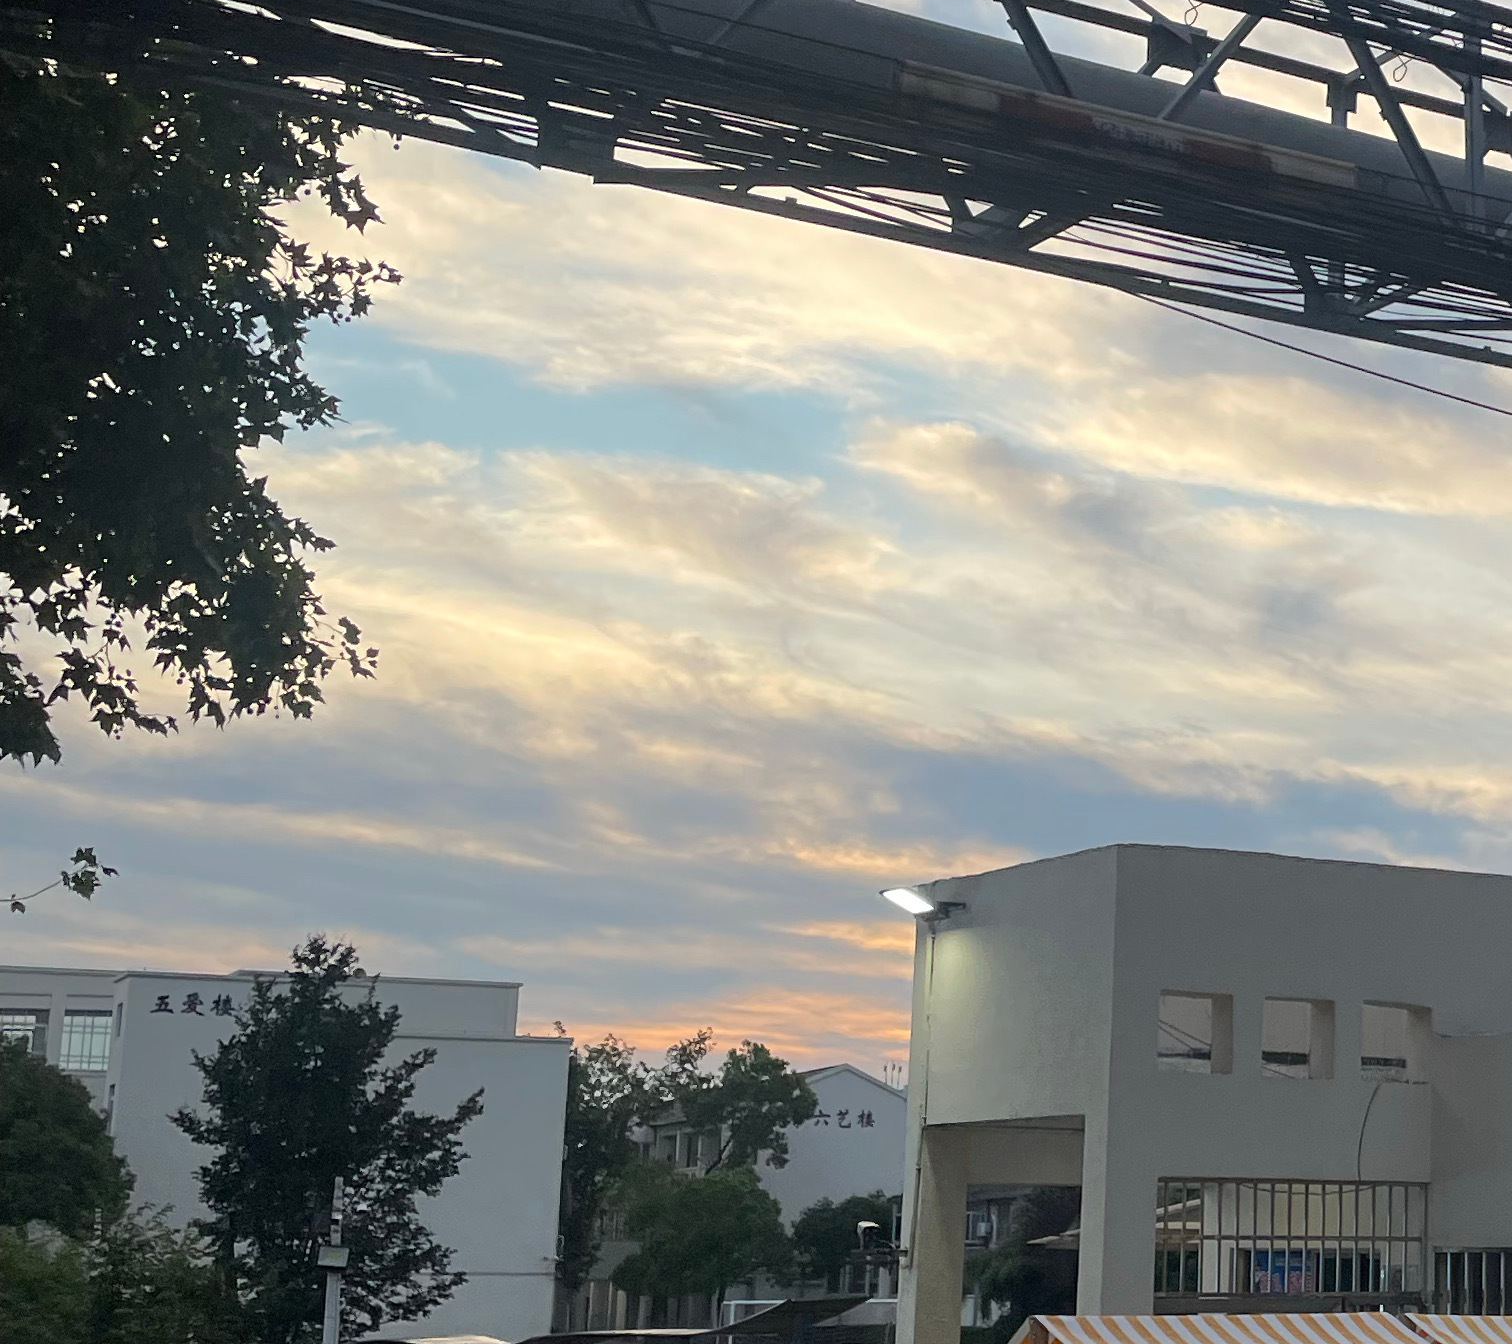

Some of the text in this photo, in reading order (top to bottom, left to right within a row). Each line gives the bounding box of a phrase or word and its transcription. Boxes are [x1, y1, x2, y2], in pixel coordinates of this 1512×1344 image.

[150, 992, 235, 1016] 五爱楼
[813, 1109, 875, 1128] 六艺楼
